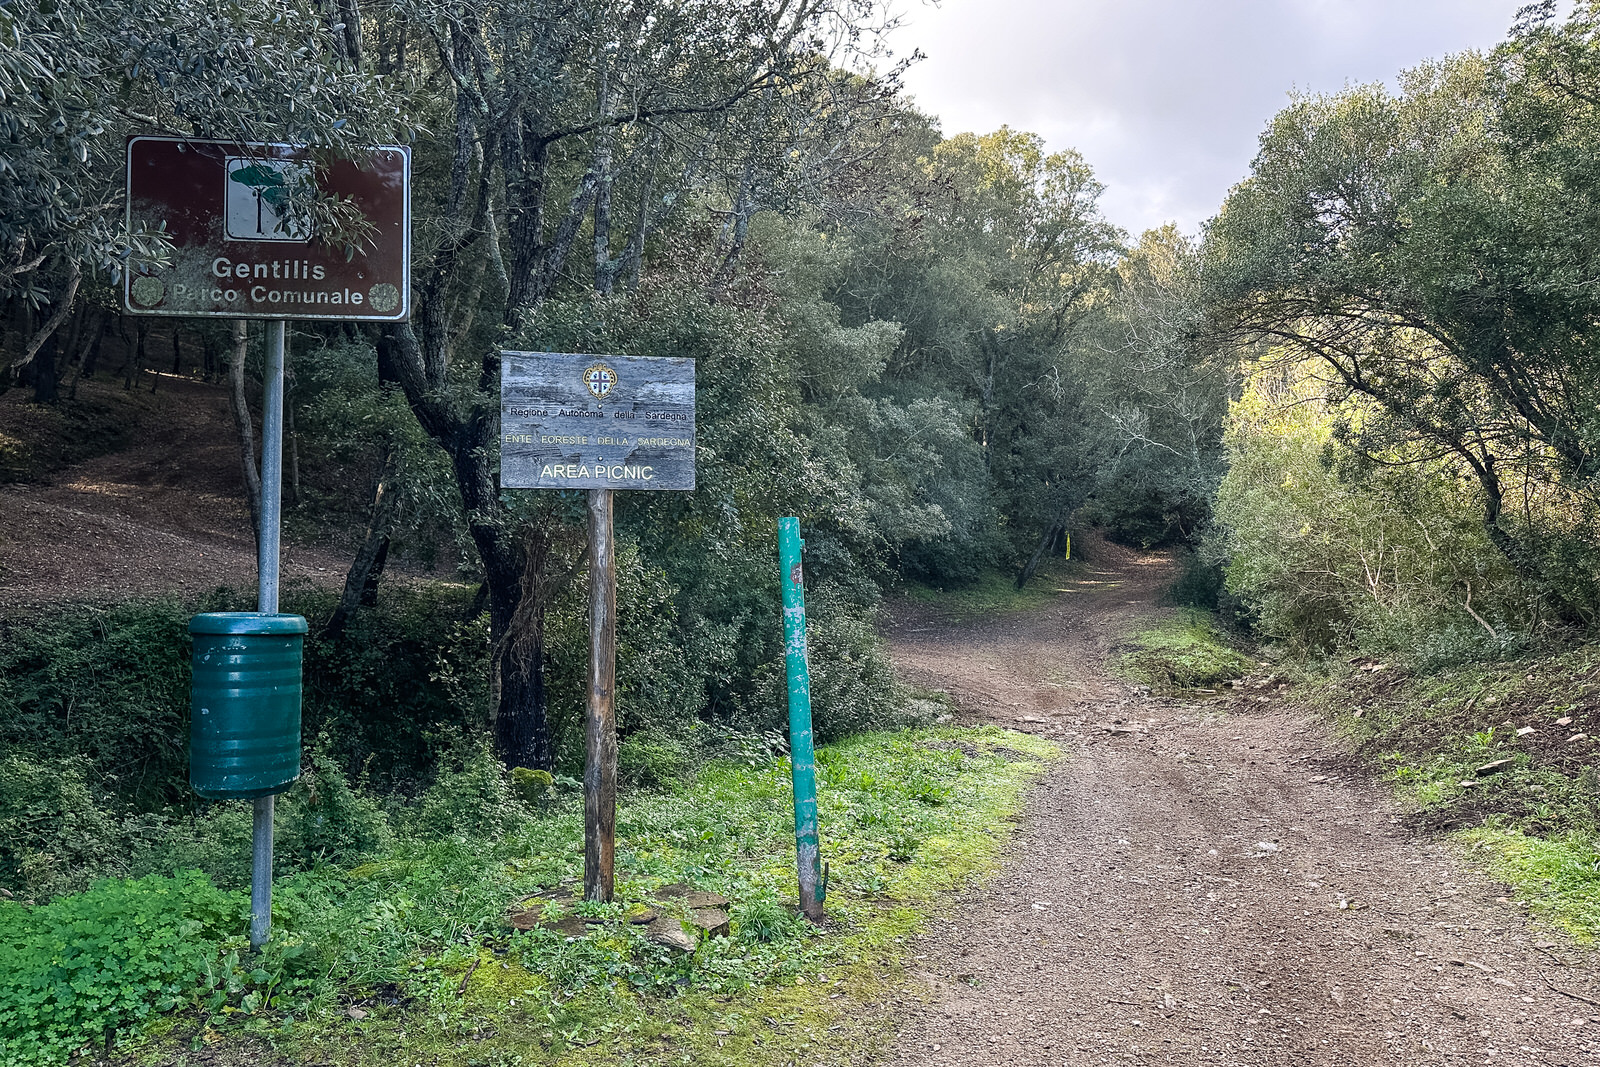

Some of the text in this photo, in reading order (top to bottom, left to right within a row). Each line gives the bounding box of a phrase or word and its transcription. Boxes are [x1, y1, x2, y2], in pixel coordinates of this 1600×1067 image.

[212, 257, 326, 281] Gentilis
[173, 283, 364, 306] Parco Comunale
[510, 407, 687, 422] Regione Autonoma della Sardegna
[505, 434, 691, 447] ENTE FORESTE DELLA SARDEGNA
[540, 464, 653, 480] AREA PICNIC
